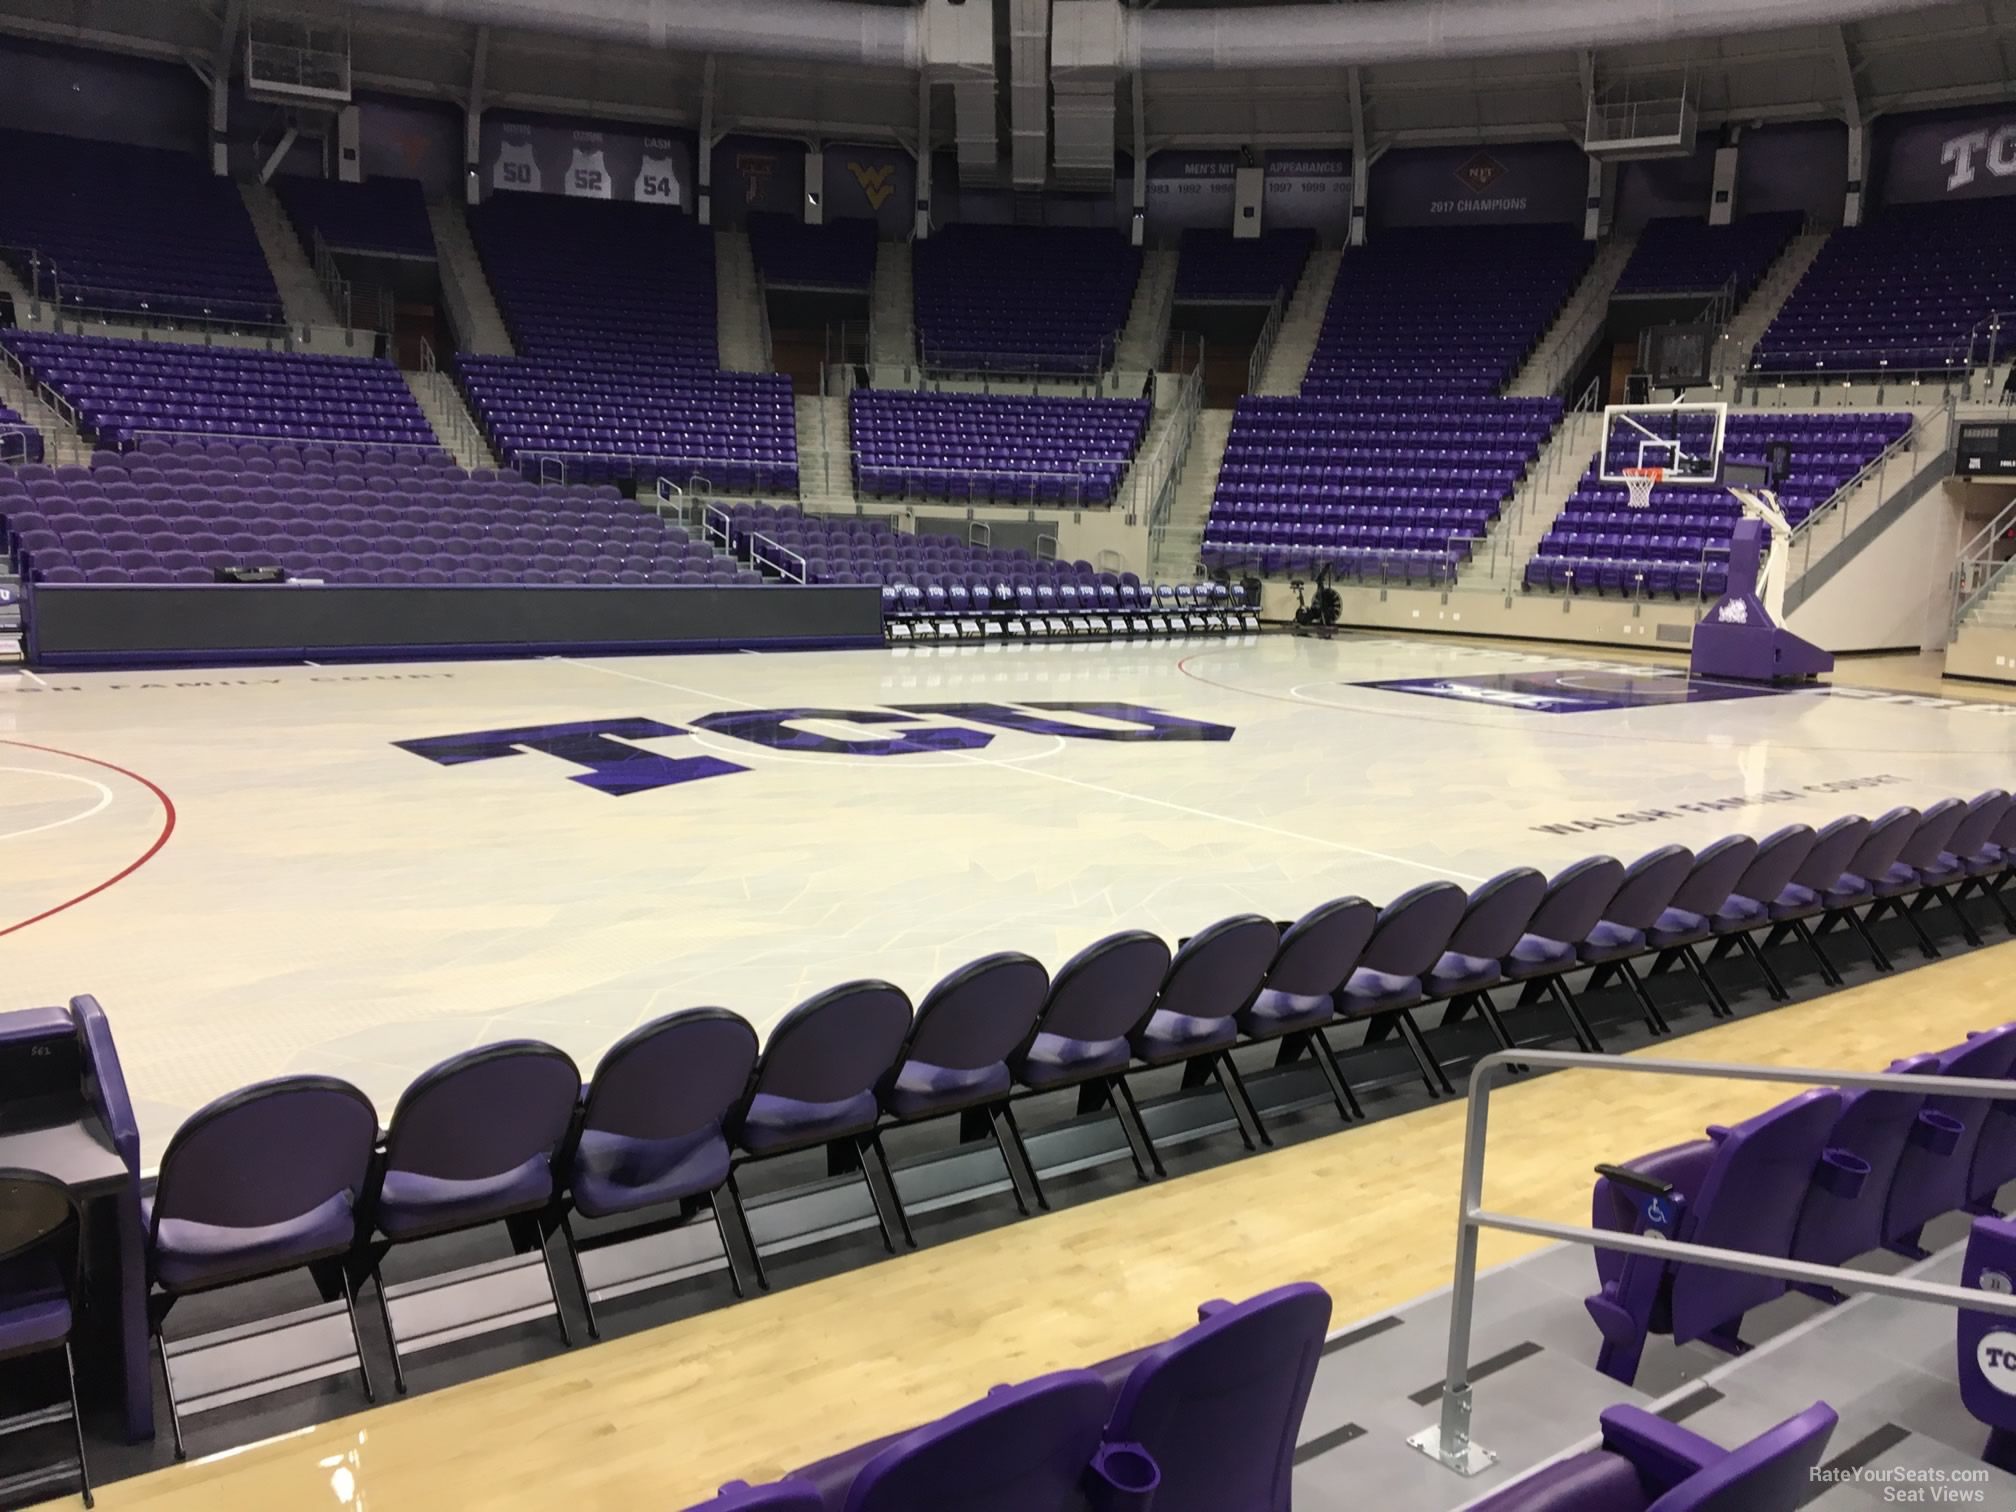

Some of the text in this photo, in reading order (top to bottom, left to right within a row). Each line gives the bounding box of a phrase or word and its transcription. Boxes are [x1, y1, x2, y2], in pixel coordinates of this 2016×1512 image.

[644, 137, 671, 150] CASH
[503, 162, 531, 184] 50
[1184, 161, 1343, 175] MEN'S NIT APPEARANCES
[574, 169, 603, 191] 52
[643, 176, 671, 197] 54
[1178, 184, 1202, 194] 1992
[1268, 182, 1292, 193] 1997
[1430, 197, 1527, 213] 2017 CHAMPIONS
[109, 679, 281, 690] FAMILY
[310, 673, 455, 682] COURT
[390, 701, 1236, 796] TCU
[1528, 774, 1912, 836] WALSH FAMILY COURT
